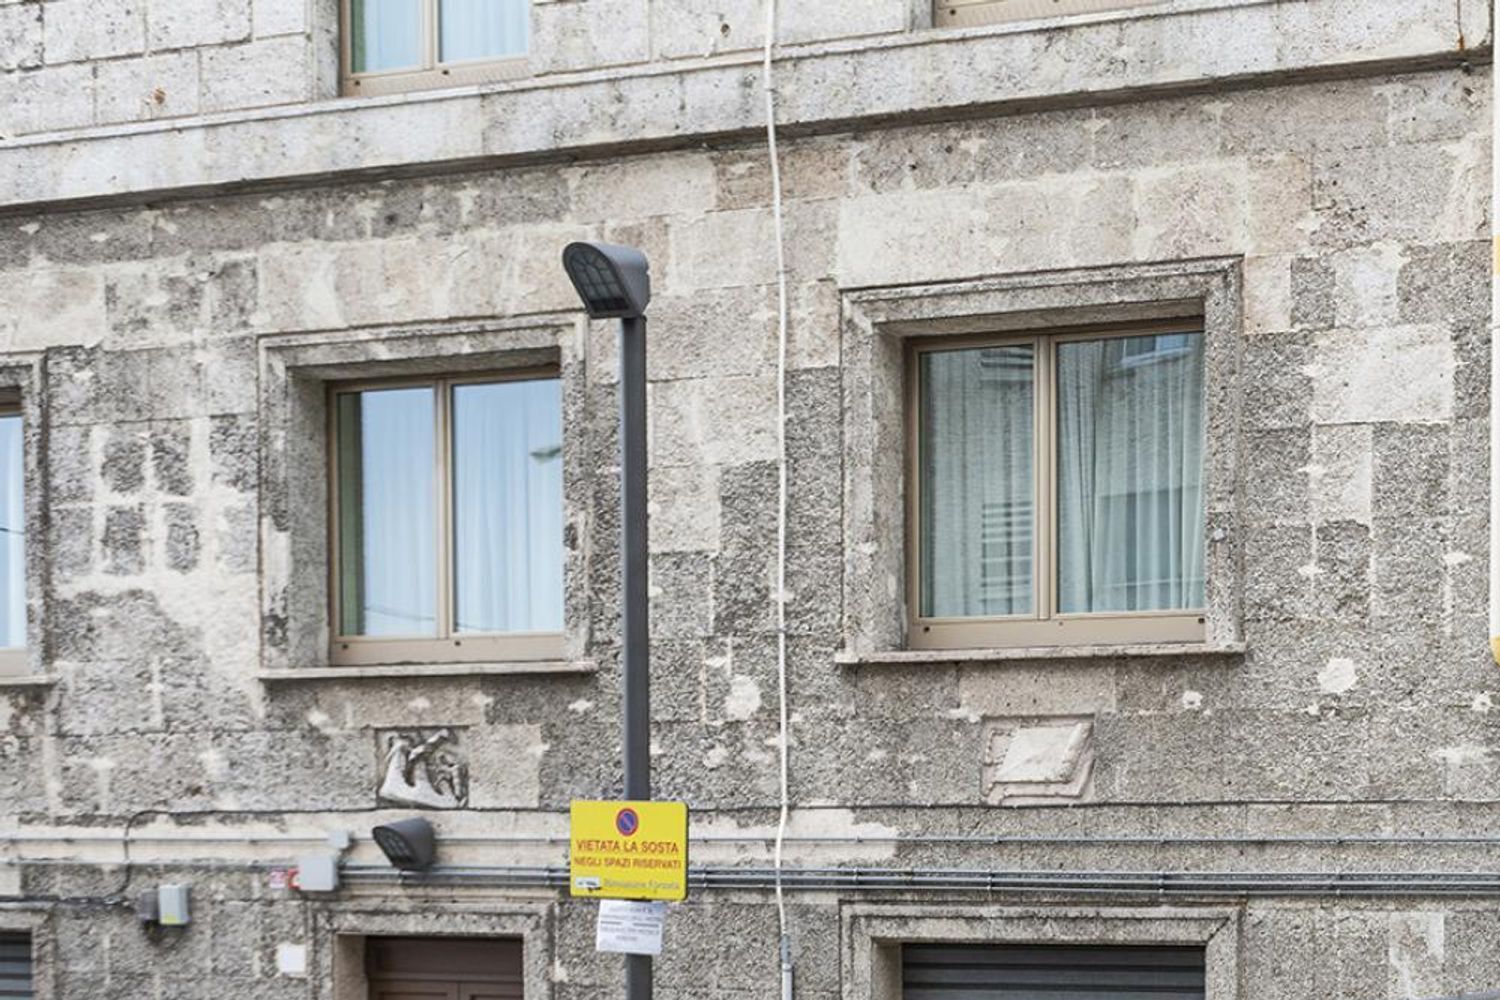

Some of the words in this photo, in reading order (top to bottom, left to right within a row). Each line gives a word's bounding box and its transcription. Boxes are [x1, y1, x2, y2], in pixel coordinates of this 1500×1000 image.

[575, 839, 620, 852] VIETATA
[624, 840, 638, 853] LA
[641, 841, 679, 854] SOSTA
[573, 857, 602, 867] NEGLI
[604, 857, 631, 868] SPAZI
[632, 858, 682, 870] RISERVATI
